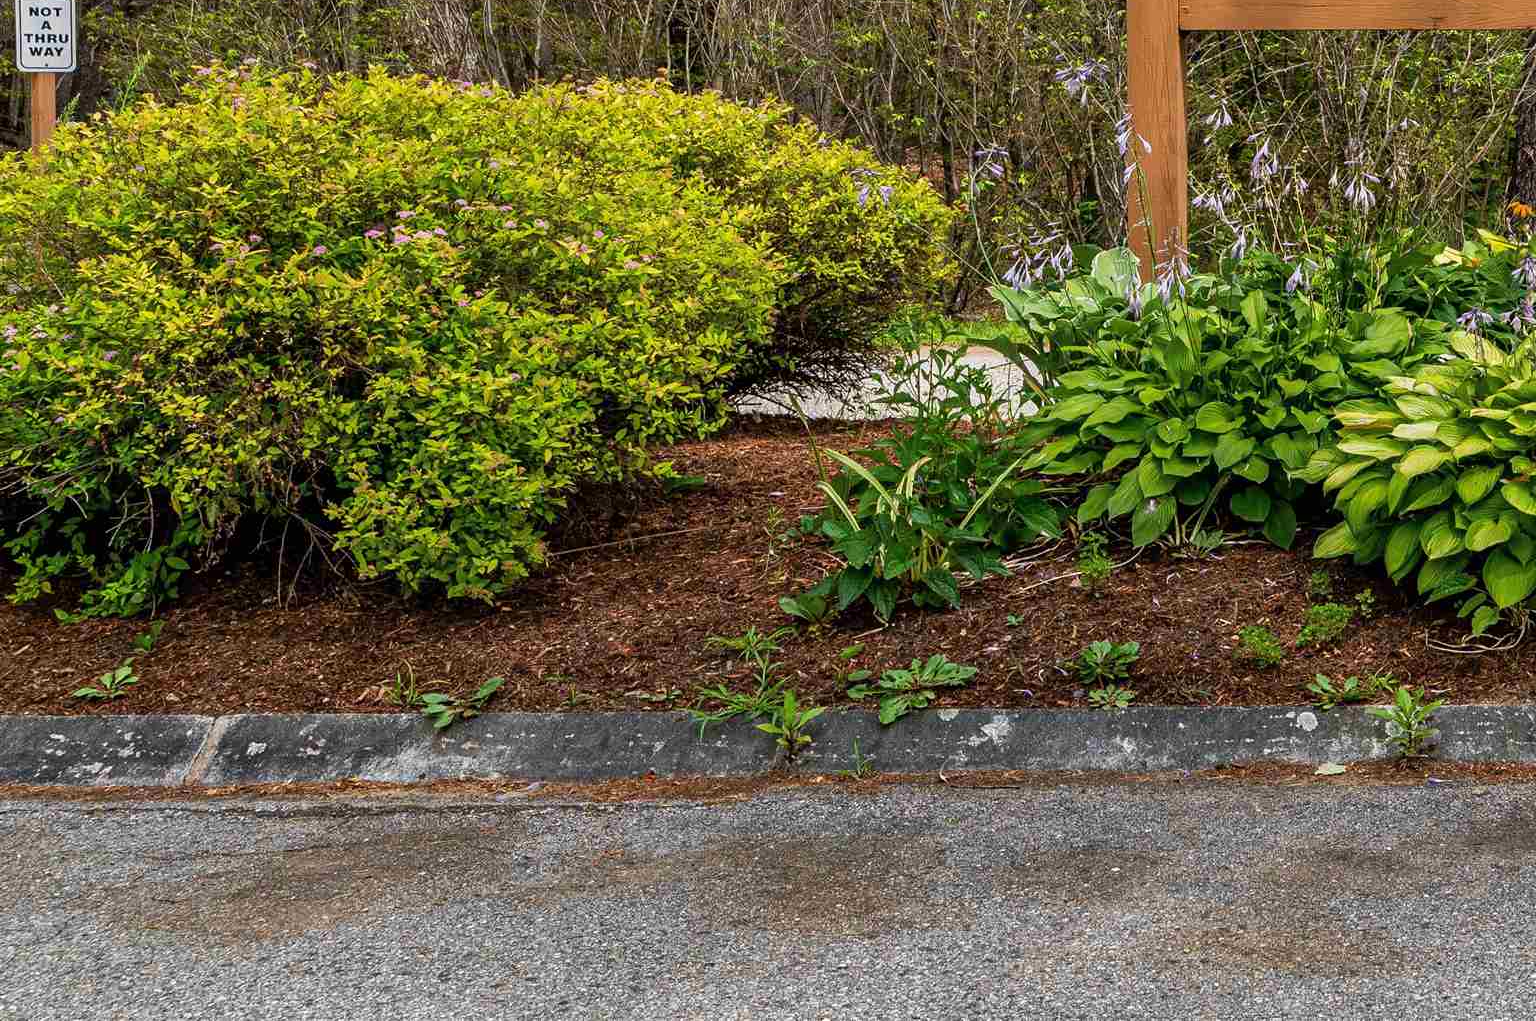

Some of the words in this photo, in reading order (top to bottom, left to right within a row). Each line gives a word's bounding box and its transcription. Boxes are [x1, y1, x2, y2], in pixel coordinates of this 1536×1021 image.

[29, 7, 63, 16] NOT
[41, 21, 51, 29] A
[24, 34, 69, 43] THRU
[29, 47, 64, 56] WAY
